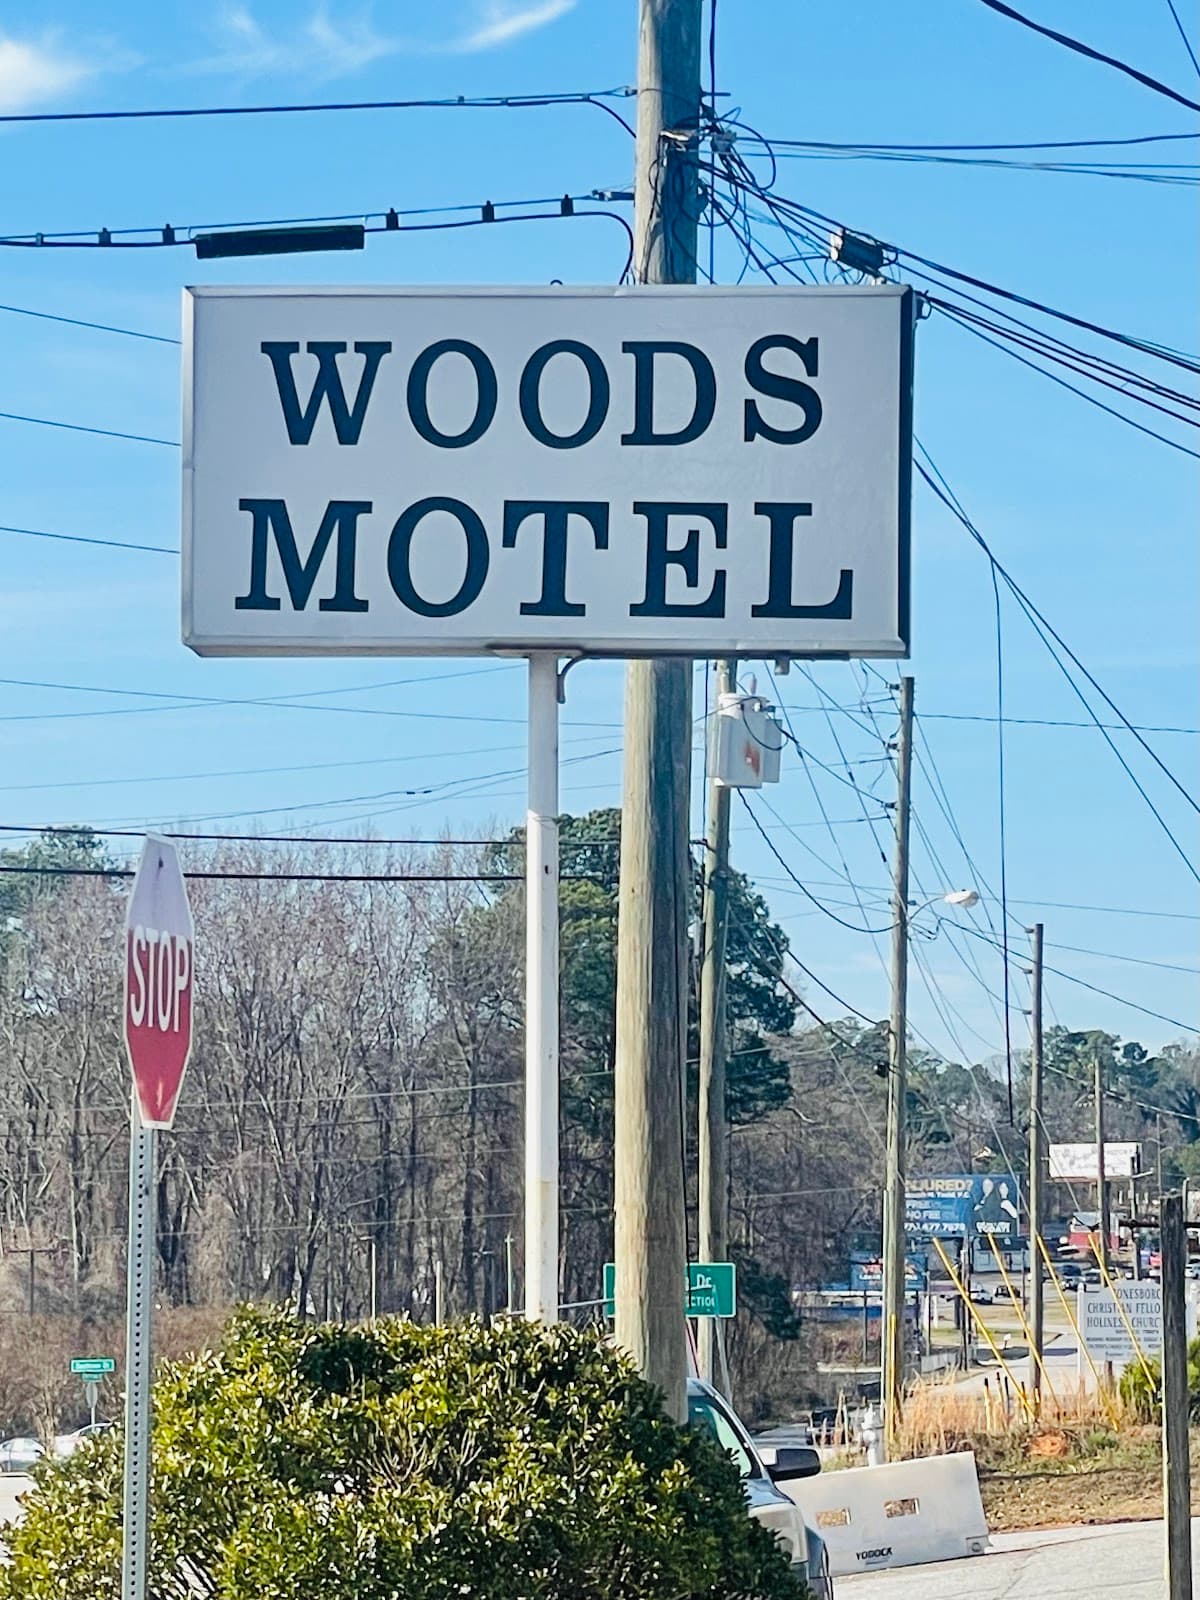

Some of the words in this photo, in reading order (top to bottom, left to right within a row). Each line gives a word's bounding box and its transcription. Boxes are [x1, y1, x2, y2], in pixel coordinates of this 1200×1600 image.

[259, 333, 823, 449] WOODS
[234, 496, 853, 619] MOTEL
[130, 924, 190, 1033] STOP
[1087, 1316, 1125, 1328] HOLINES
[1132, 1316, 1161, 1328] CHURC
[1136, 1302, 1161, 1314] FELLO
